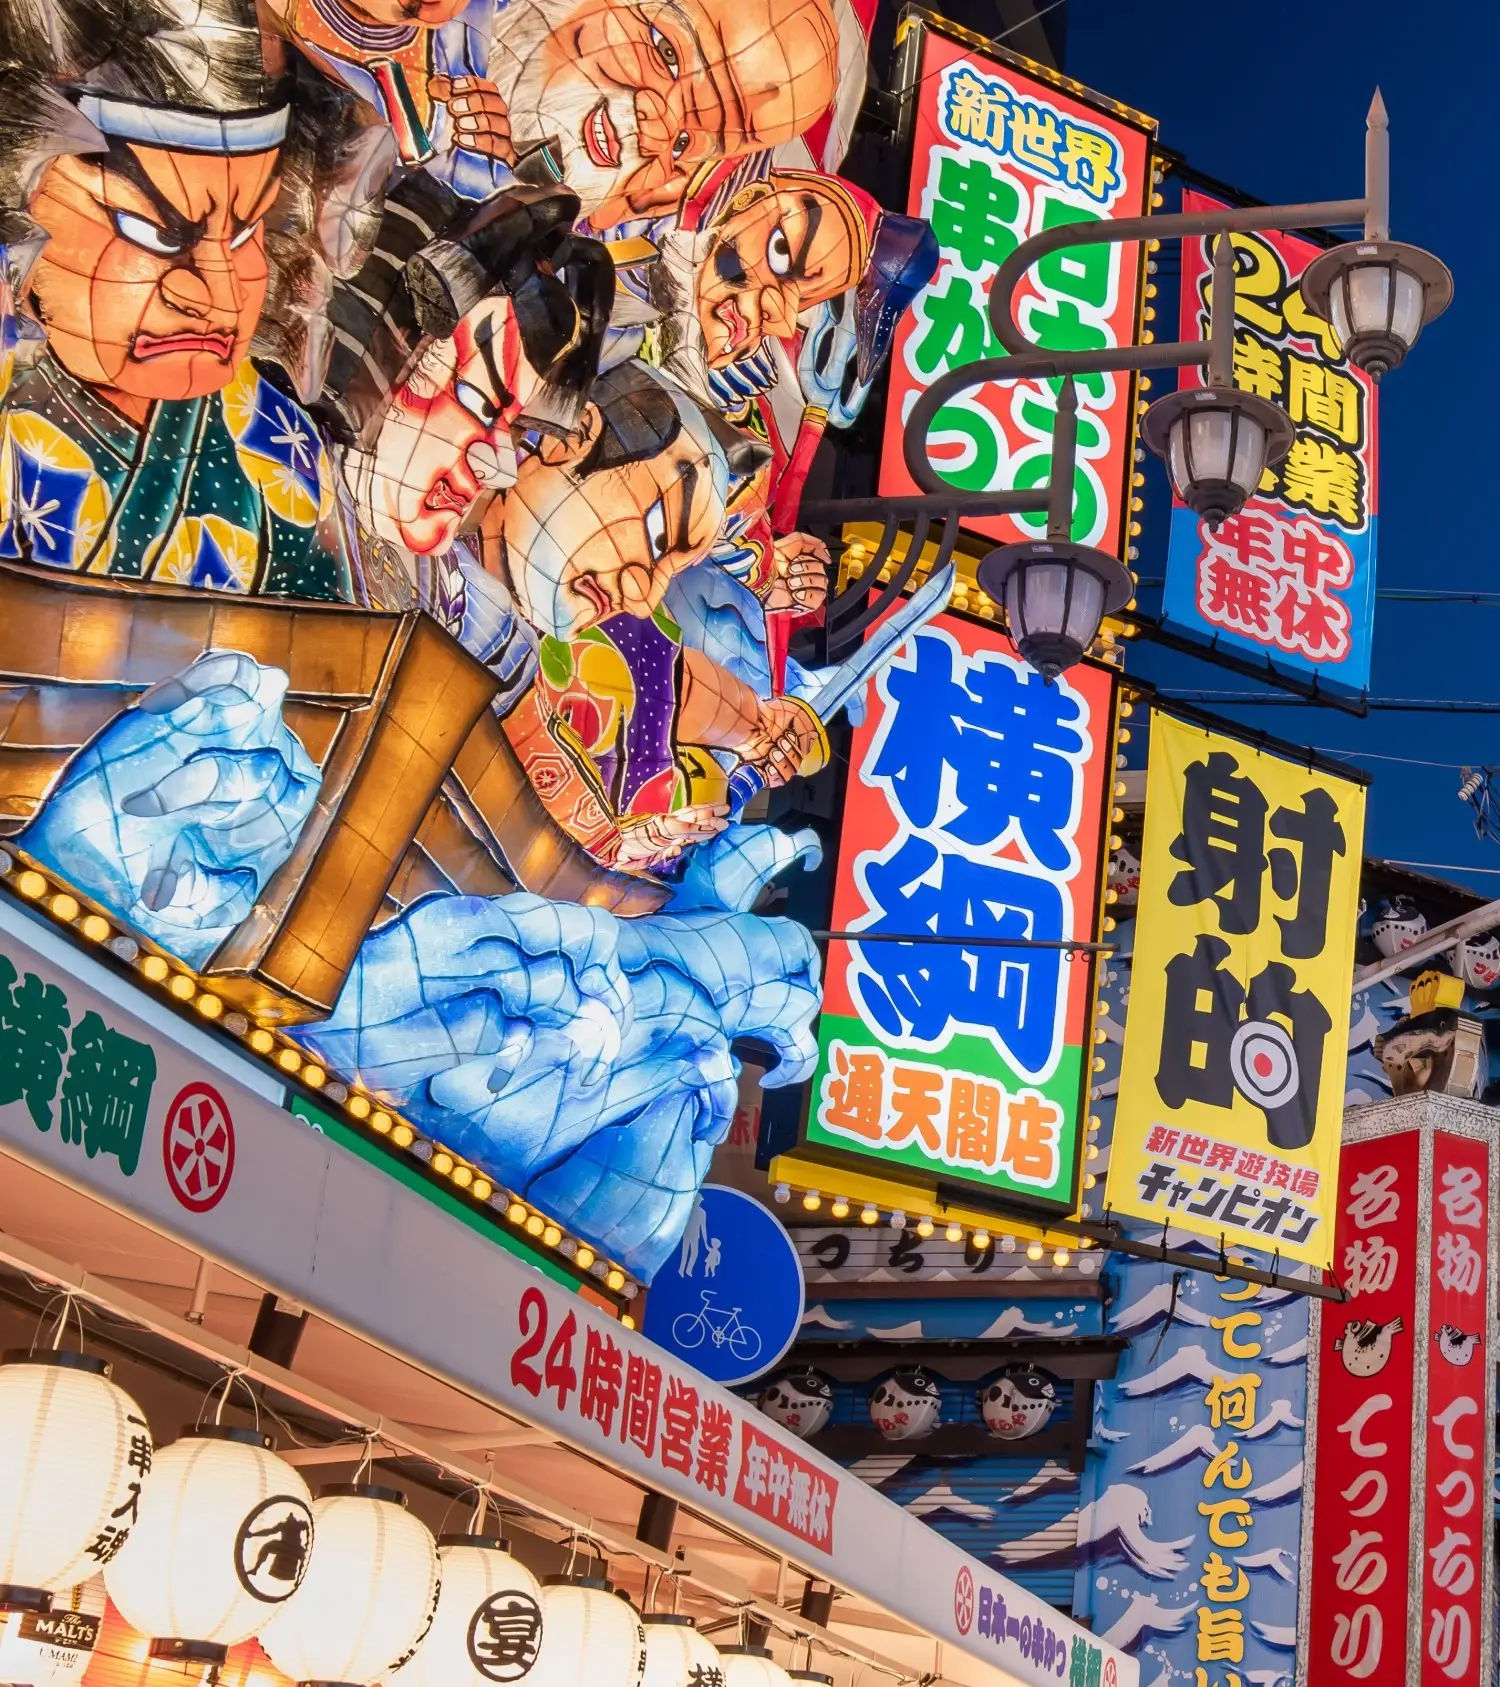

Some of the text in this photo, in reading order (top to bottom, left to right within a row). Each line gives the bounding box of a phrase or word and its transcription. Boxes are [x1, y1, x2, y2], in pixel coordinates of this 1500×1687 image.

[948, 73, 1118, 196] 新世界
[914, 155, 1020, 493] 串かつ
[1203, 515, 1349, 588] 年中
[1204, 555, 1347, 657] 無休
[854, 634, 1084, 1074] 横綱
[1156, 751, 1347, 1149] 射的
[0, 954, 158, 1177] 横綱
[824, 1048, 1060, 1182] 通天閣店
[1138, 1163, 1320, 1245] チャンピオン
[1147, 1125, 1321, 1199] 新世界遊技場
[1343, 1163, 1400, 1299] 名物
[1436, 1163, 1484, 1297] 名物
[510, 1286, 831, 1542] 24時間営業 年中無休
[35, 1619, 95, 1642] MALT'S
[978, 1585, 1067, 1678] 日本一の串かつ
